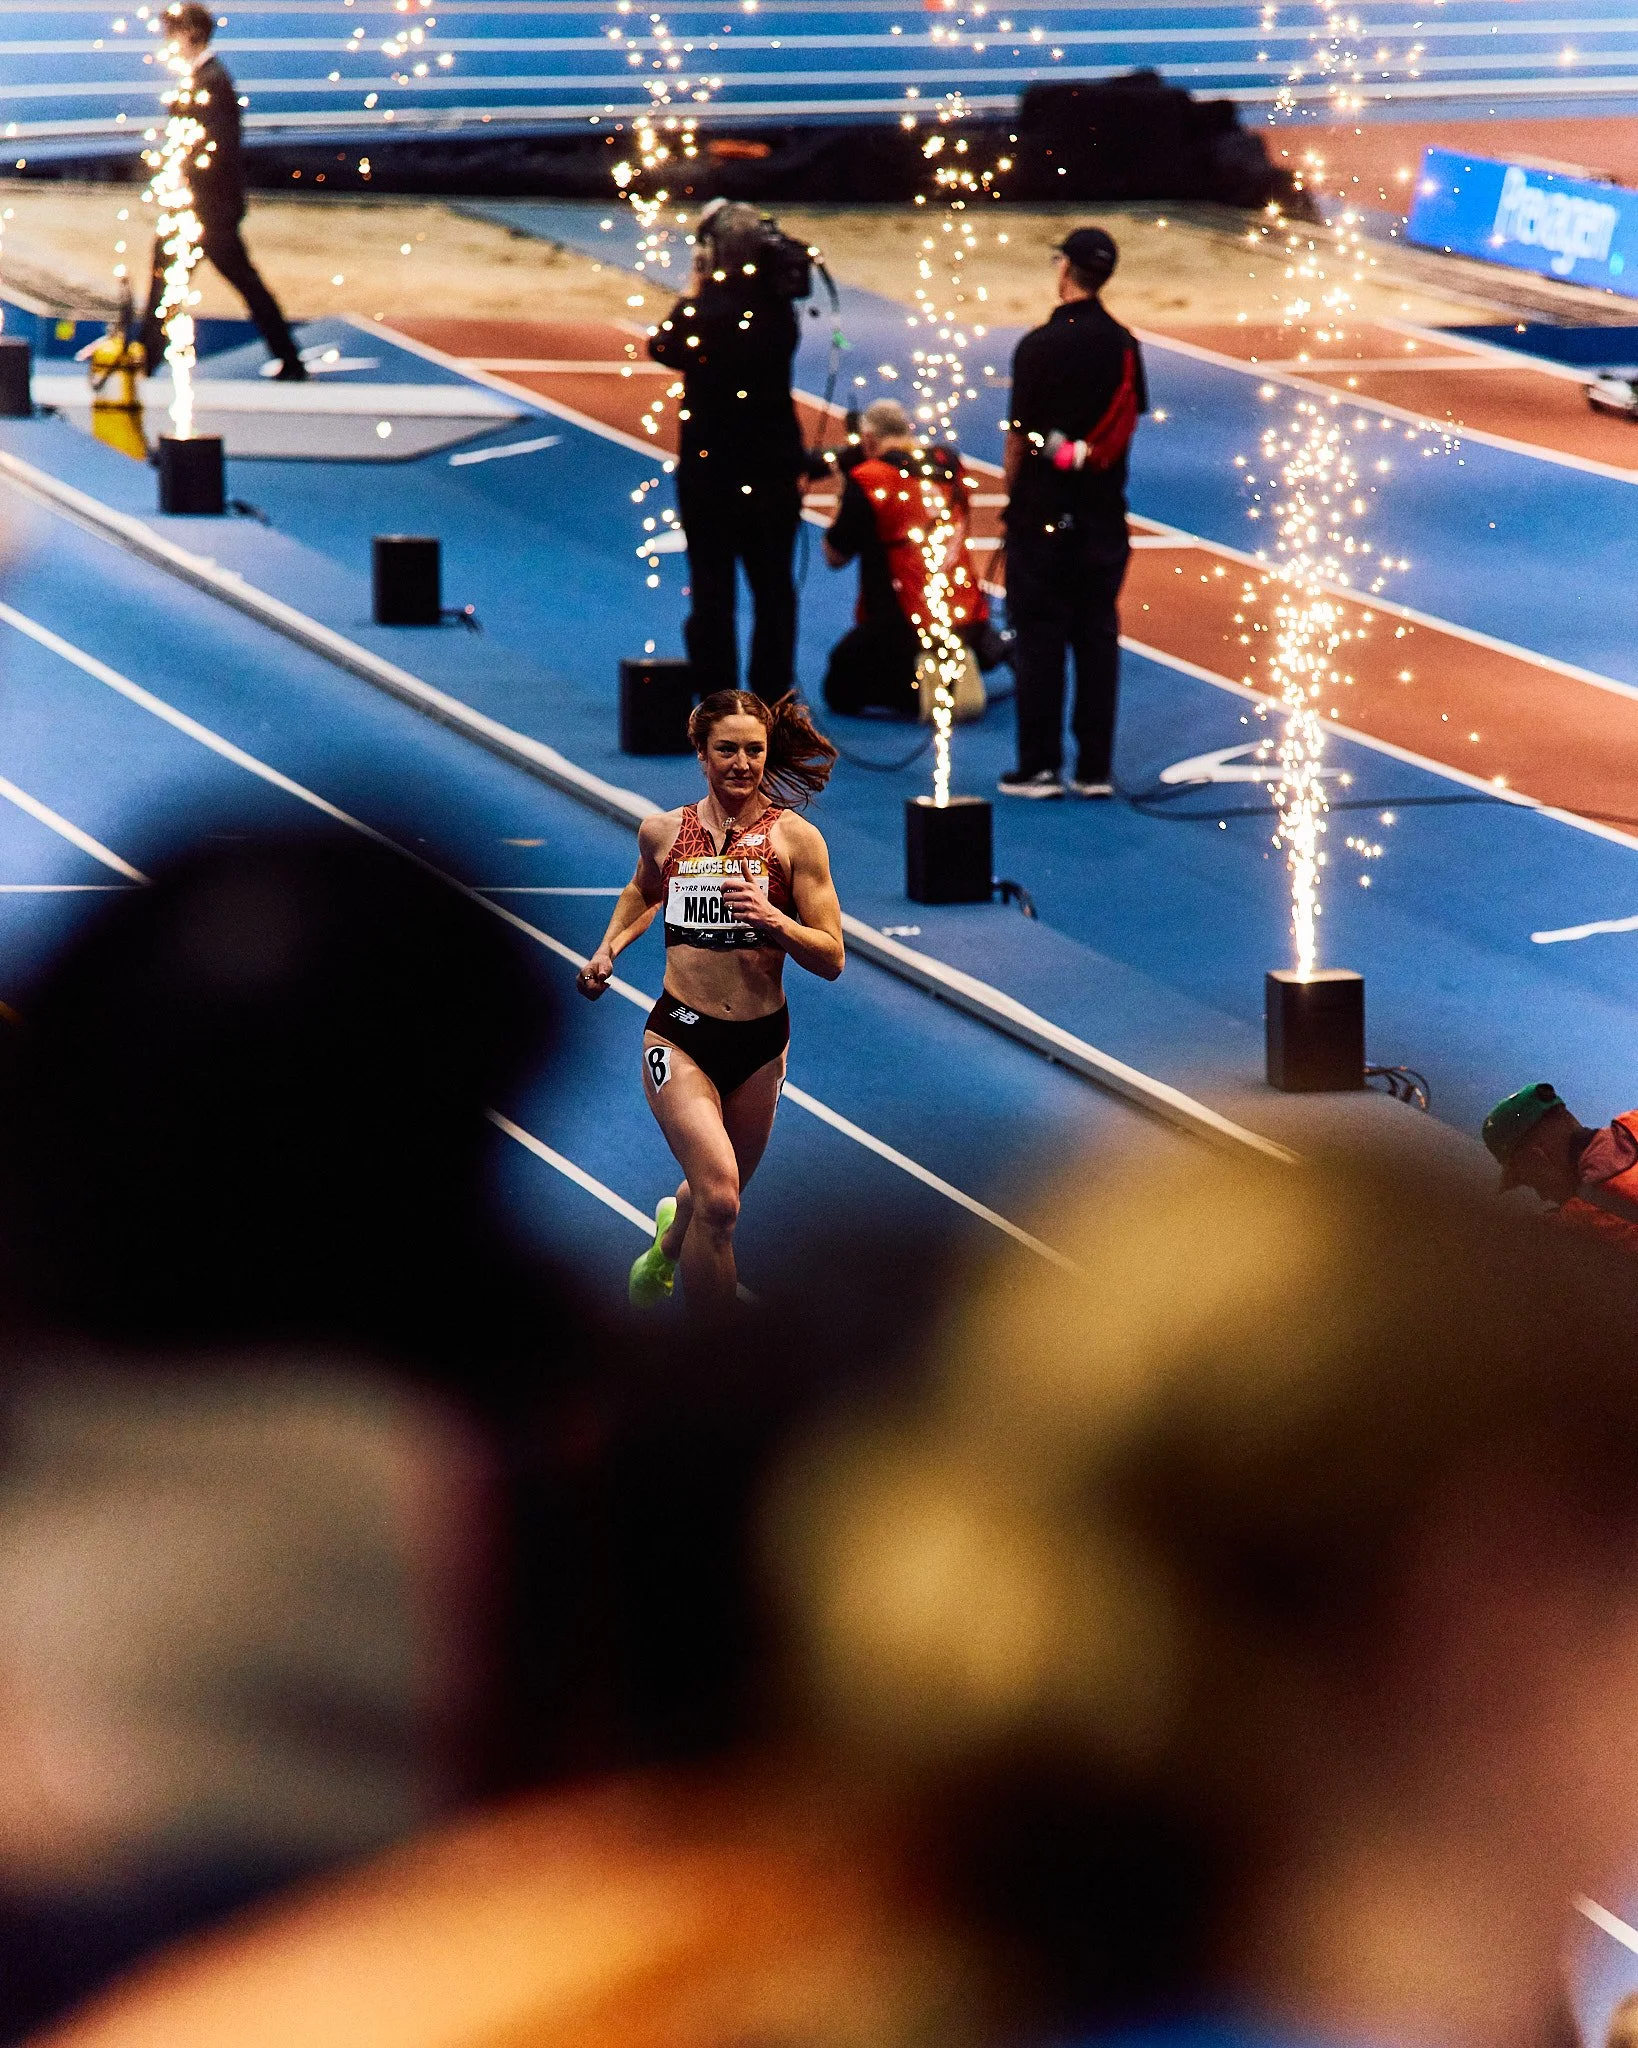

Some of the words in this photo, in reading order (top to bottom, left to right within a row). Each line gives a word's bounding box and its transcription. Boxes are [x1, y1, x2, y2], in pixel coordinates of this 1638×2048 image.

[678, 860, 723, 875] MILLROSE
[683, 896, 742, 924] MACK
[648, 1047, 666, 1087] 8
